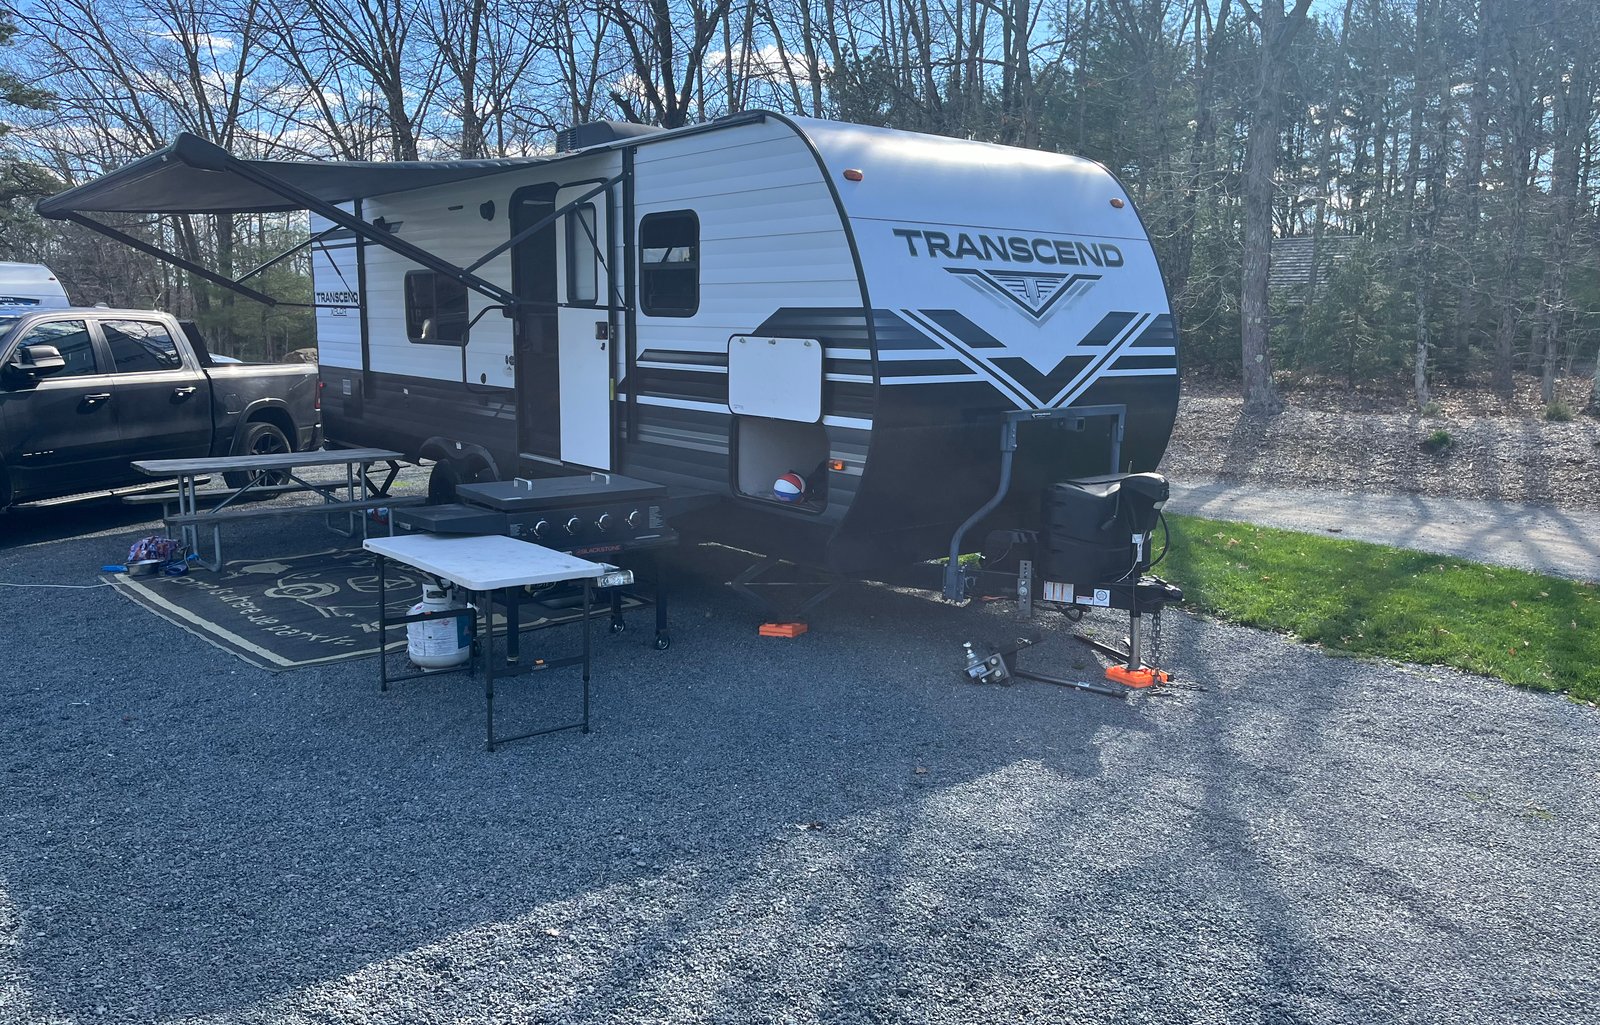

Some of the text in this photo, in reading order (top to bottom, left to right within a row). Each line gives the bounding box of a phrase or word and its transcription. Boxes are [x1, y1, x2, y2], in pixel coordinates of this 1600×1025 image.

[892, 228, 1125, 268] TRANSCEND
[317, 292, 358, 303] TRANSCEND
[581, 545, 620, 554] BLACKSTONE
[219, 593, 262, 615] where
[248, 614, 280, 626] we
[261, 624, 329, 642] park
